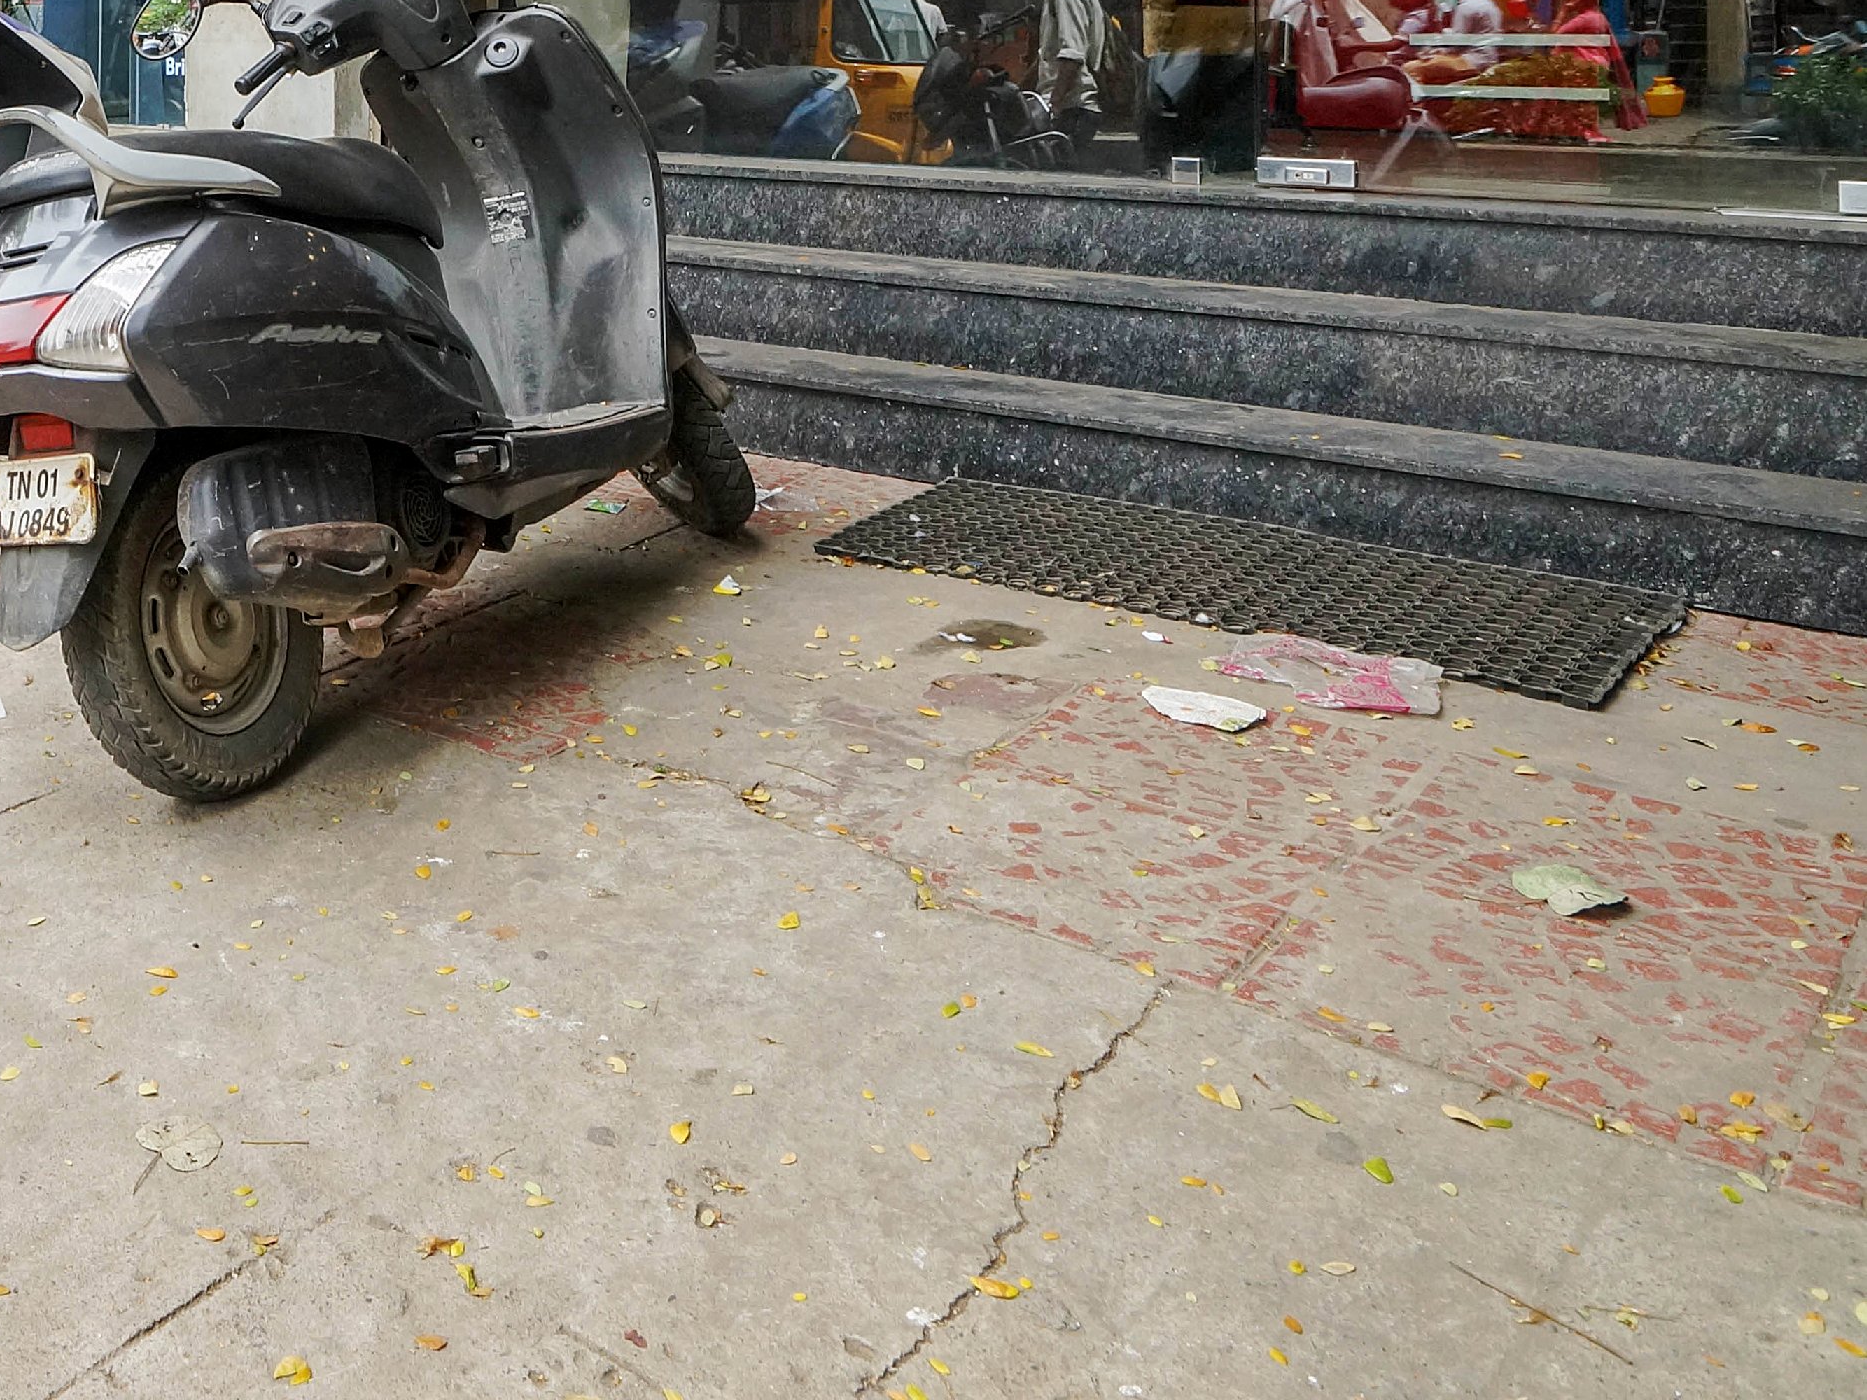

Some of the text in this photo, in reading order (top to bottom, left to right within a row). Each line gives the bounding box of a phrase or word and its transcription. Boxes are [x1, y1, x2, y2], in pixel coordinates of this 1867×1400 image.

[7, 468, 58, 501] TN 01
[18, 506, 71, 538] 0849
